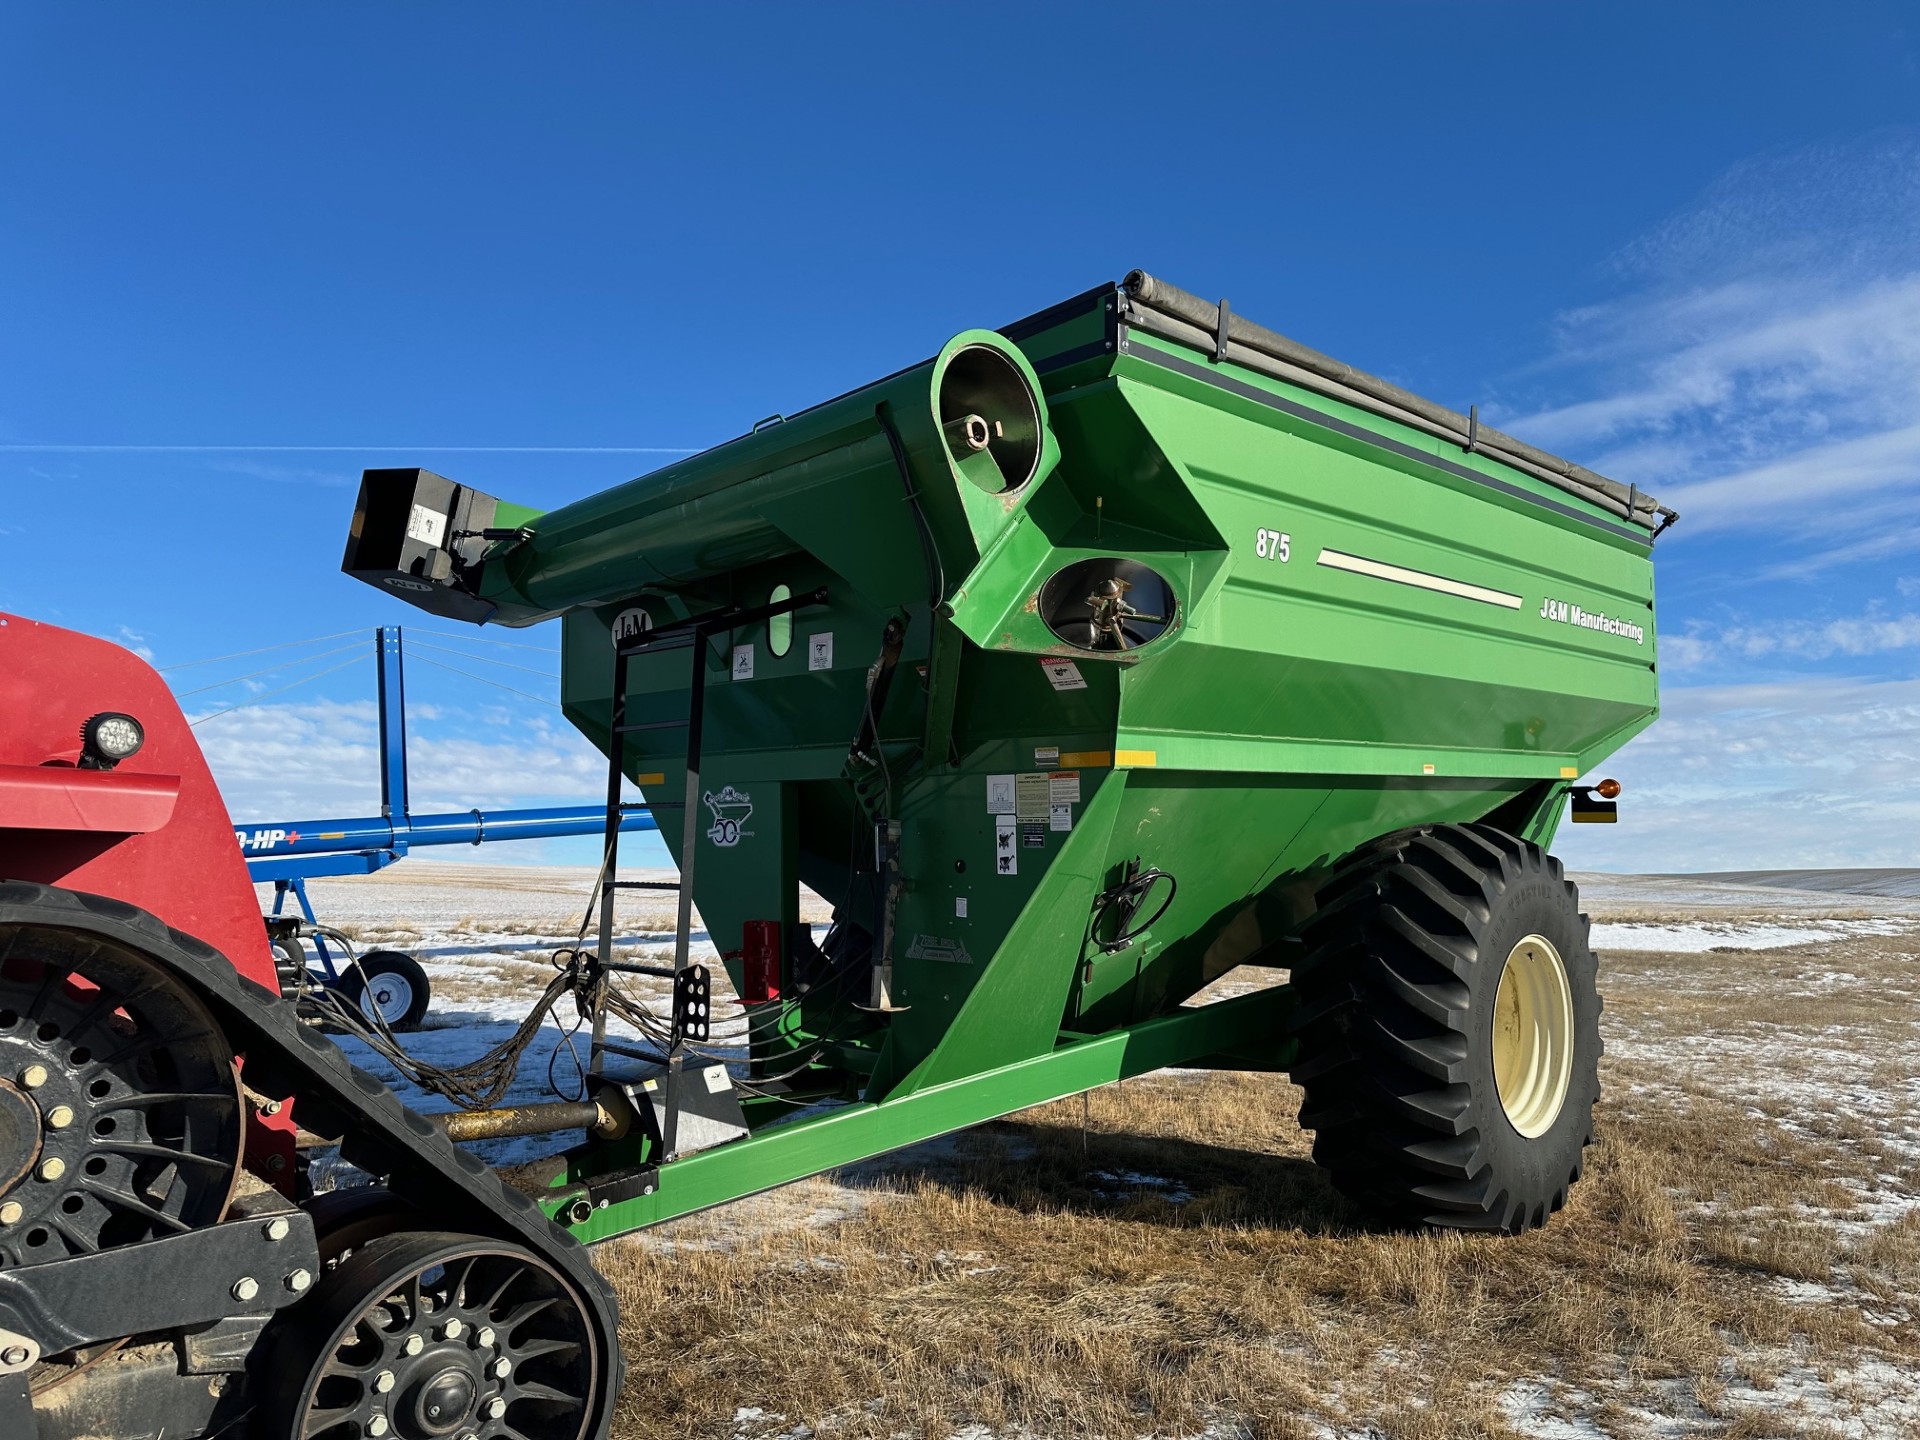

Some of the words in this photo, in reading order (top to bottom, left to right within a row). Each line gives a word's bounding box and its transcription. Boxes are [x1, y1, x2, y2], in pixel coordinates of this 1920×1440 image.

[1255, 527, 1291, 564] 875
[1540, 597, 1568, 624] J&M
[1570, 603, 1643, 646] Manufacturing
